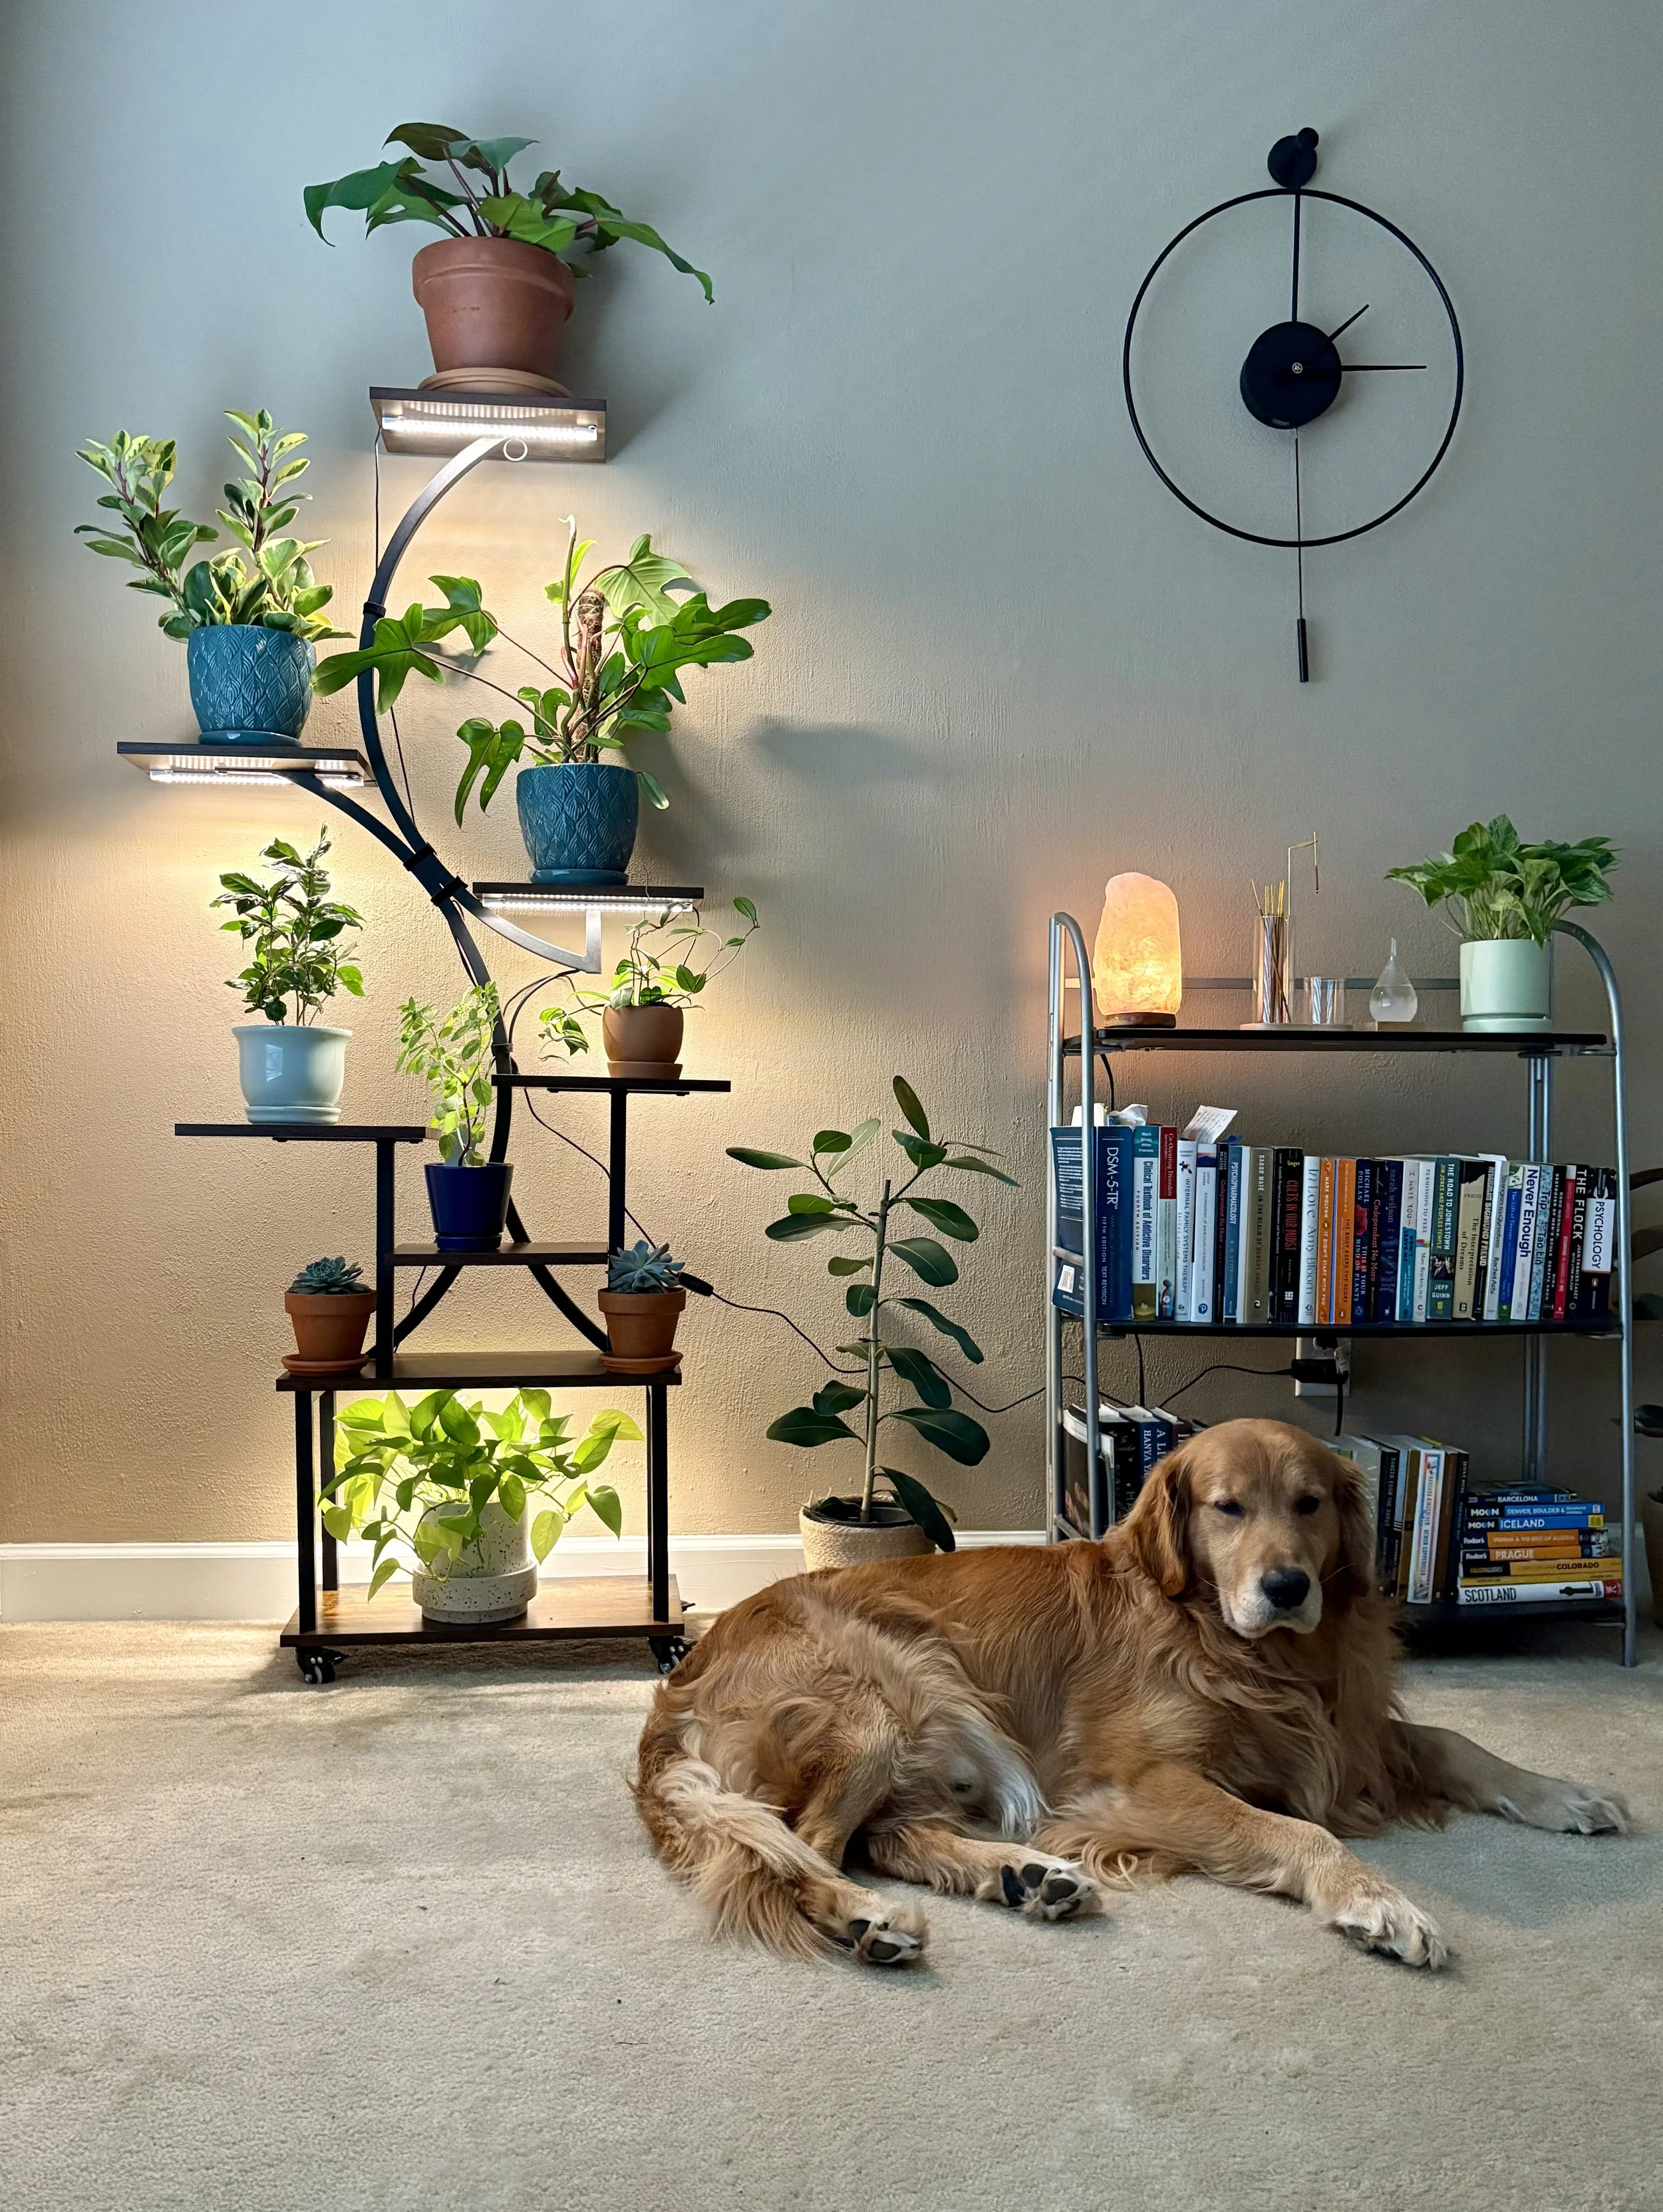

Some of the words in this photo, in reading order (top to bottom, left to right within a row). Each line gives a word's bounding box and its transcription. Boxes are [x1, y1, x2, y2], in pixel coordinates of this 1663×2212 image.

[1143, 1161, 1153, 1183] Clinical
[1308, 1169, 1319, 1181] In
[1389, 1169, 1398, 1192] sarah
[1575, 1169, 1587, 1194] THE
[1143, 1186, 1153, 1210] Textbook
[1229, 1162, 1239, 1224] PSYCHOPHARMACOLOGY
[1286, 1180, 1298, 1201] CULTS
[1525, 1169, 1539, 1206] Never
[1538, 1190, 1550, 1210] Trip
[1307, 1186, 1318, 1218] Love
[1388, 1194, 1397, 1222] wilson
[1445, 1198, 1453, 1207] TO
[1219, 1218, 1225, 1227] No
[1285, 1214, 1297, 1227] OUR
[1372, 1199, 1381, 1248] Codependent
[1482, 1202, 1492, 1239] SIGMUND
[1495, 1214, 1503, 1248] Ourselves
[1572, 1200, 1585, 1240] FLOCK
[1142, 1220, 1152, 1248] Addictive
[1285, 1230, 1296, 1250] MIDST
[1306, 1226, 1316, 1252] Amy
[1519, 1210, 1535, 1258] Enough
[1537, 1231, 1546, 1248] Tao
[1592, 1201, 1605, 1268] PSYCHOLOGY
[1141, 1250, 1151, 1280] Disorders
[1355, 1260, 1360, 1270] ON
[1372, 1250, 1378, 1260] No
[1467, 1234, 1477, 1285] Interpretation
[1479, 1240, 1489, 1266] FREUD
[1306, 1258, 1316, 1294] Bloom
[1143, 1430, 1152, 1461] HANYA
[1156, 1429, 1166, 1438] A
[1500, 1518, 1545, 1529] ICELAND
[1495, 1550, 1534, 1559] PRAGUE
[1465, 1588, 1517, 1603] SCOTLAND
